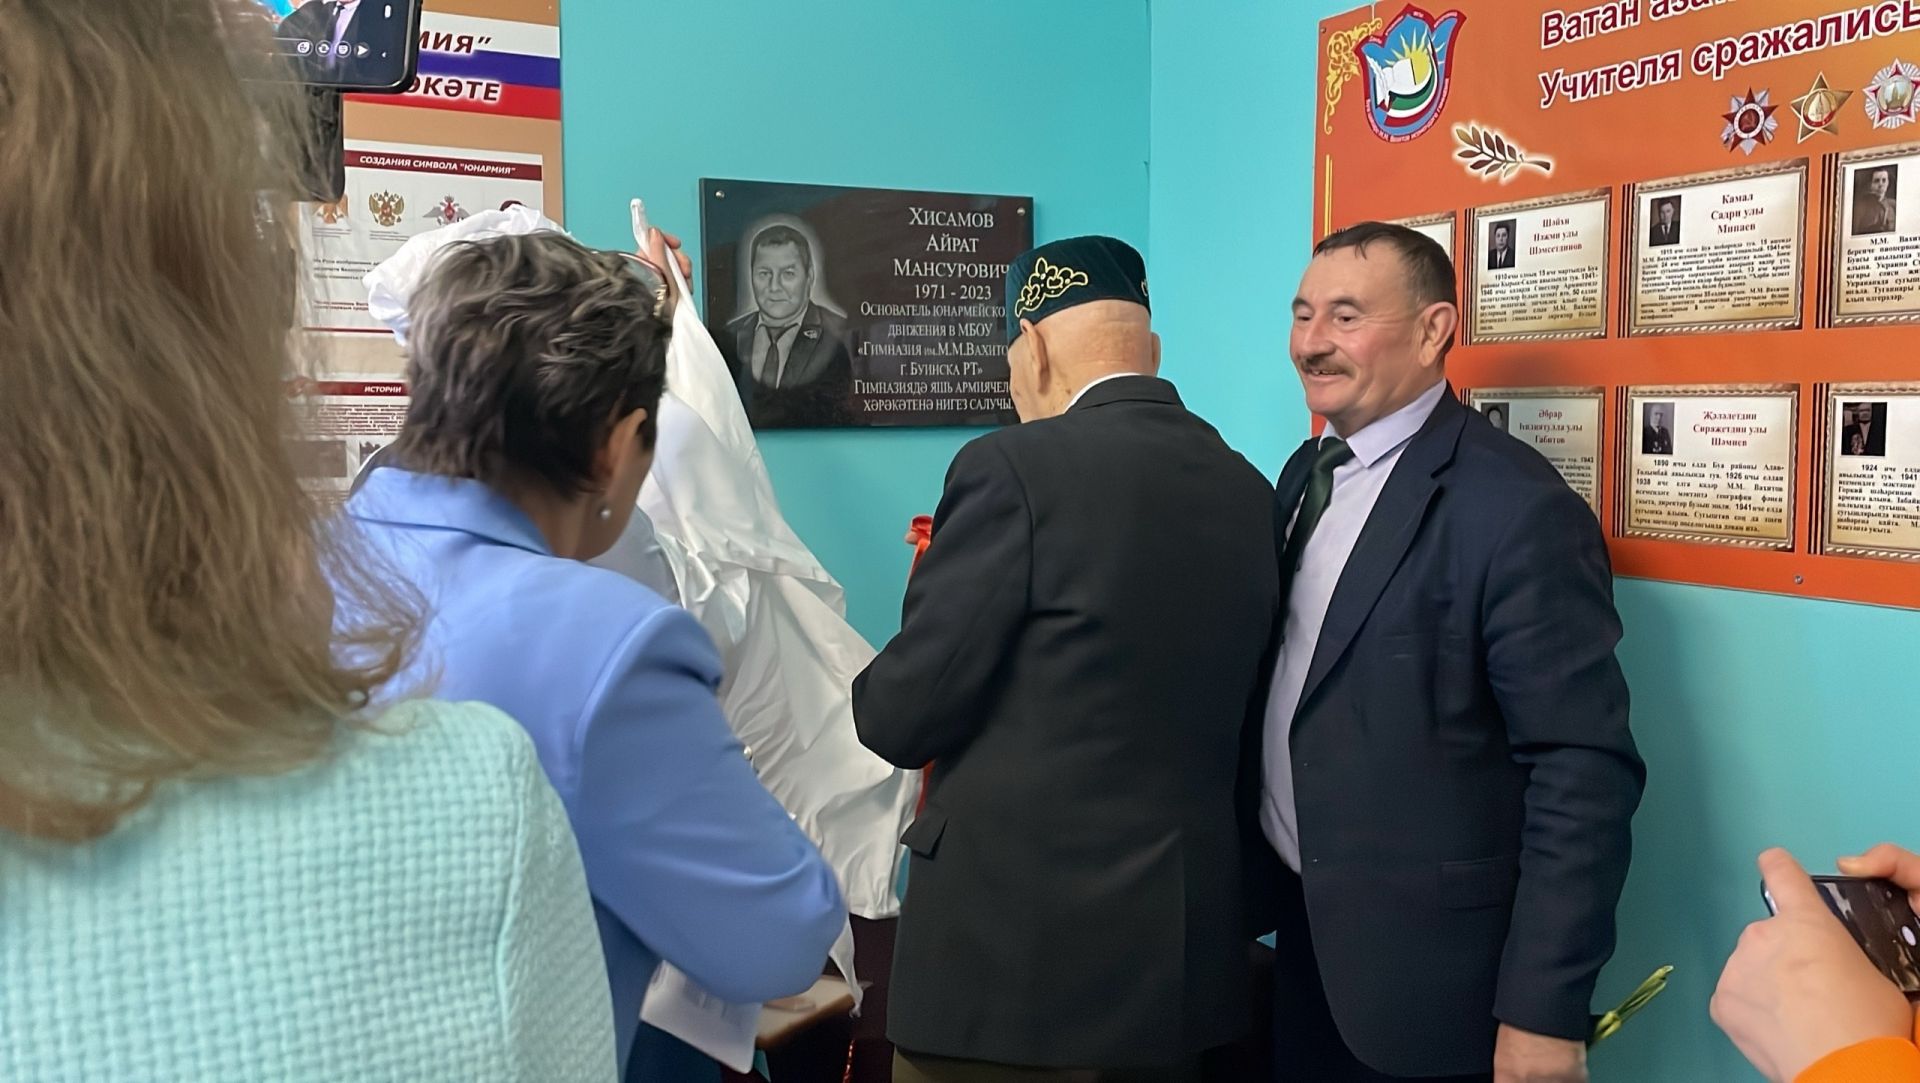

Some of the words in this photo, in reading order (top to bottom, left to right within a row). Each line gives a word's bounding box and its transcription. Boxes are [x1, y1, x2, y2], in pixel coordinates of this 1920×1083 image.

[1543, 1, 1639, 46] Ватан
[1541, 53, 1680, 106] Учителя
[359, 155, 411, 167] СОЗДАНИЯ
[412, 159, 458, 171] СИМВОЛА
[1722, 193, 1754, 205] Камал
[1743, 207, 1764, 220] улы
[915, 284, 946, 300] 1971
[959, 285, 992, 300] 2023
[932, 303, 1007, 318] ЮНАРМЕЙСКО
[957, 323, 993, 337] МБОУ
[364, 385, 402, 393] ИСТОРИИ
[1748, 426, 1767, 436] улы
[1861, 464, 1878, 472] 1924
[1901, 473, 1918, 481] 1941
